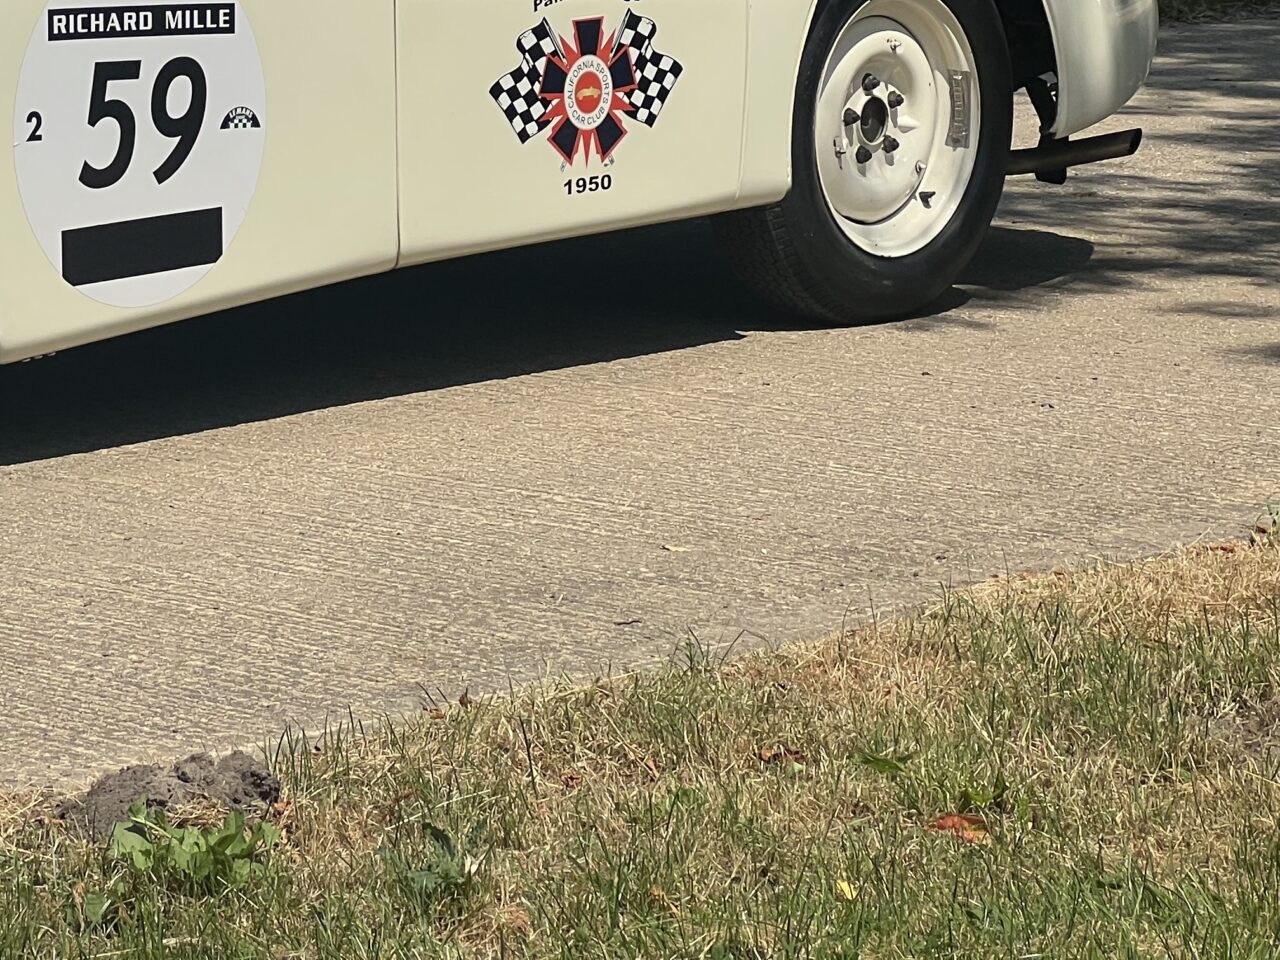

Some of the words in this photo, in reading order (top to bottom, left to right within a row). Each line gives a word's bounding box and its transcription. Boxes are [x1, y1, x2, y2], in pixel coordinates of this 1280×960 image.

[53, 11, 153, 35] RICHARD
[165, 9, 230, 30] MILLE
[567, 60, 595, 108] CALIFORNIA
[595, 63, 610, 105] SPORTS
[25, 110, 43, 143] 2
[78, 56, 207, 189] 59
[571, 109, 586, 125] CAR
[586, 106, 606, 126] CLUB
[563, 174, 612, 195] 1950
